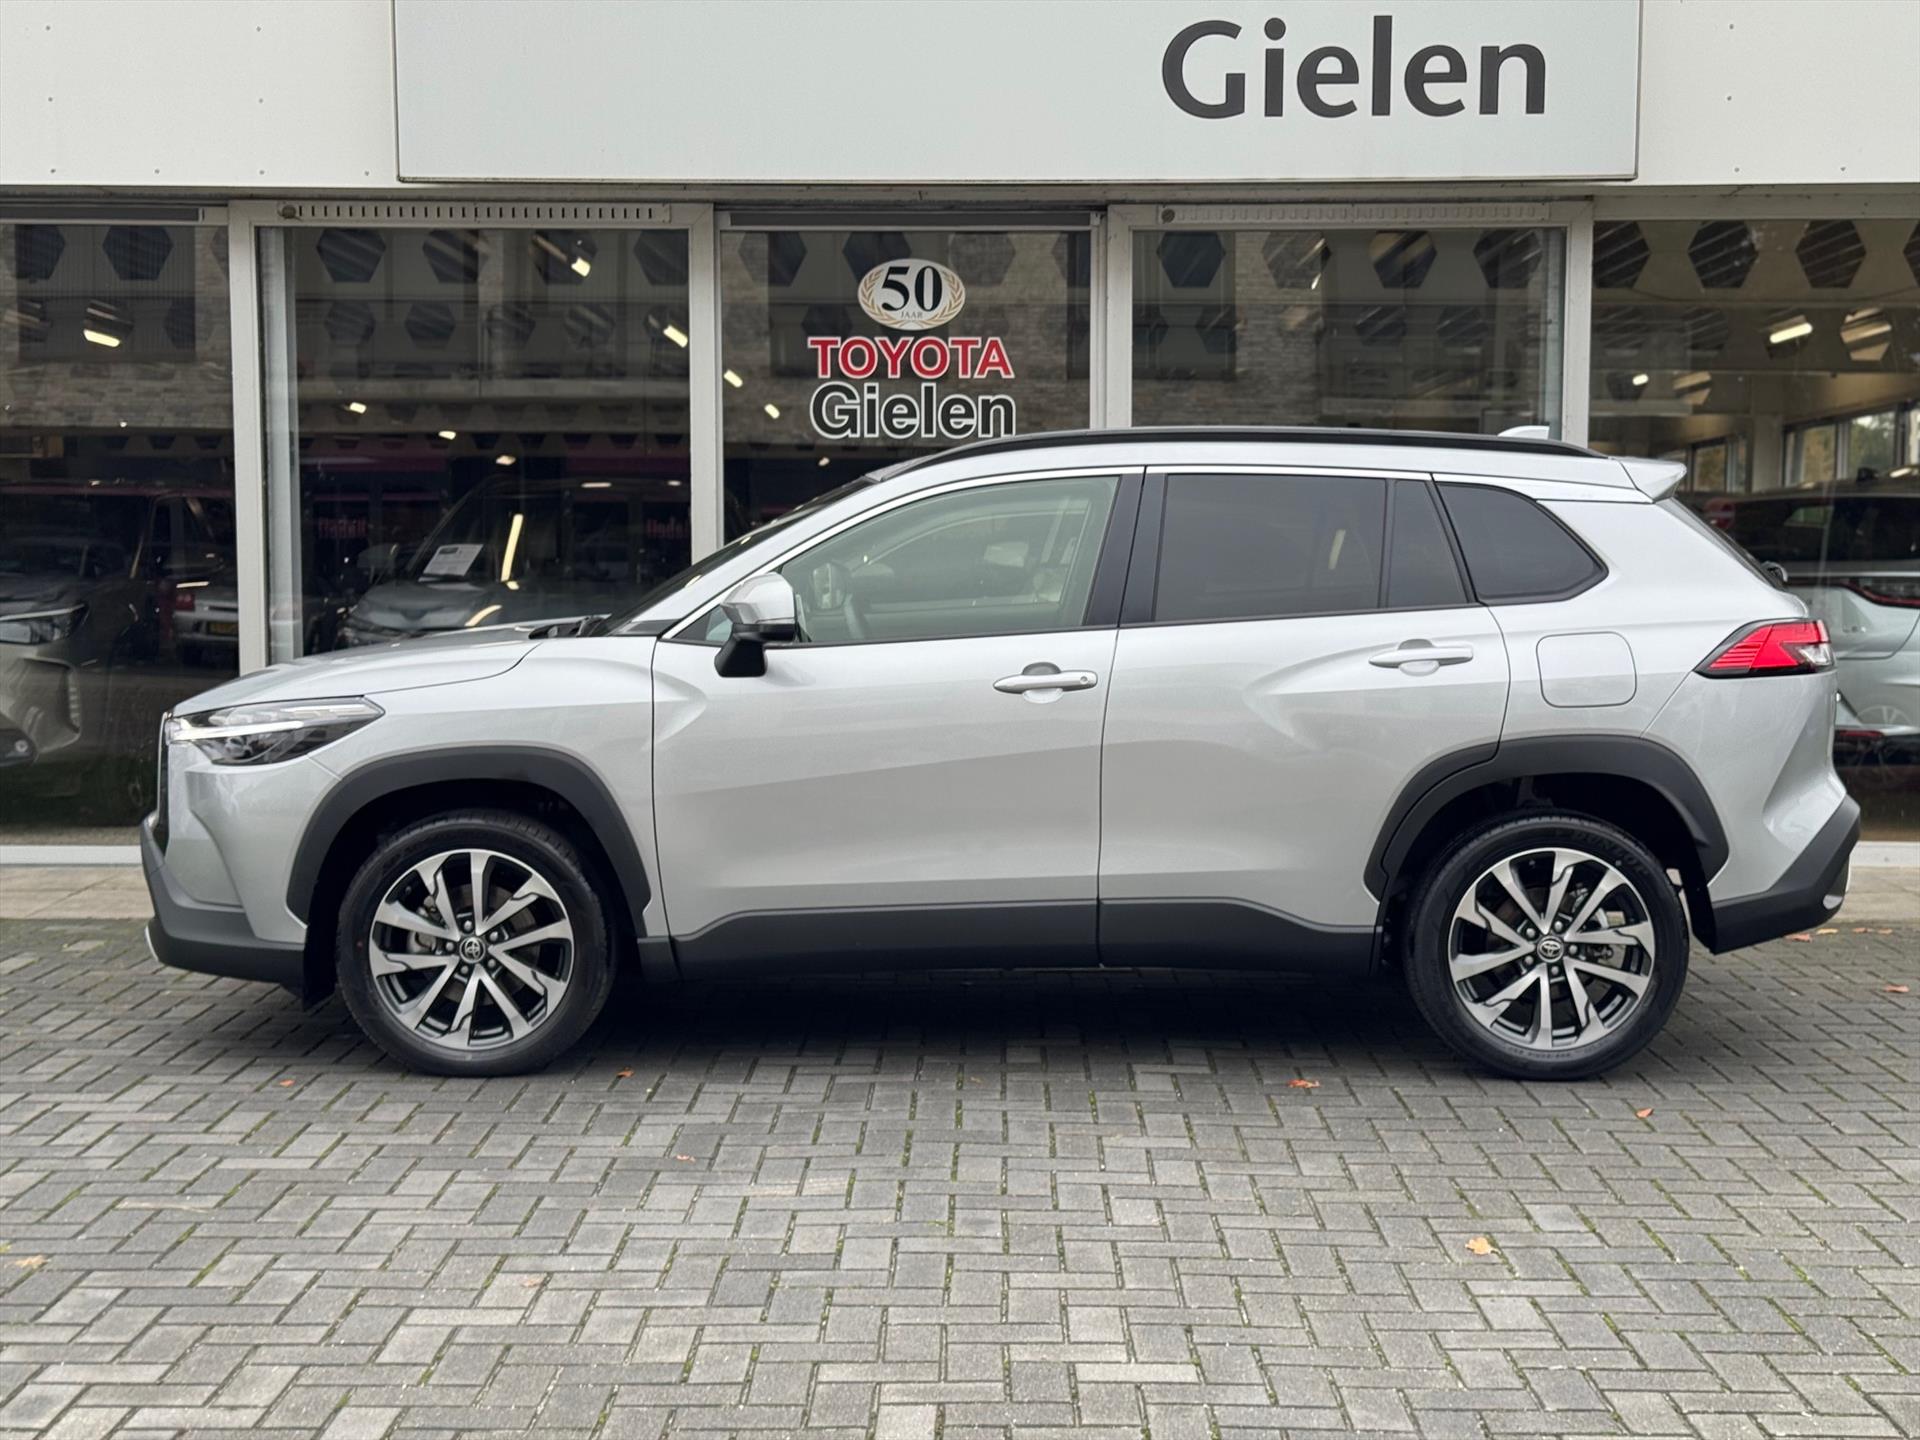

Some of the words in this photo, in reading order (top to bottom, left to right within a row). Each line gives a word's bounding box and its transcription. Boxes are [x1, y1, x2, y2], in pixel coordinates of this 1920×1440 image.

[1161, 15, 1546, 119] Gielen
[881, 265, 943, 312] 50
[901, 311, 924, 319] JAAR
[807, 336, 1016, 379] TOYOTA
[809, 381, 1016, 439] Gielen
